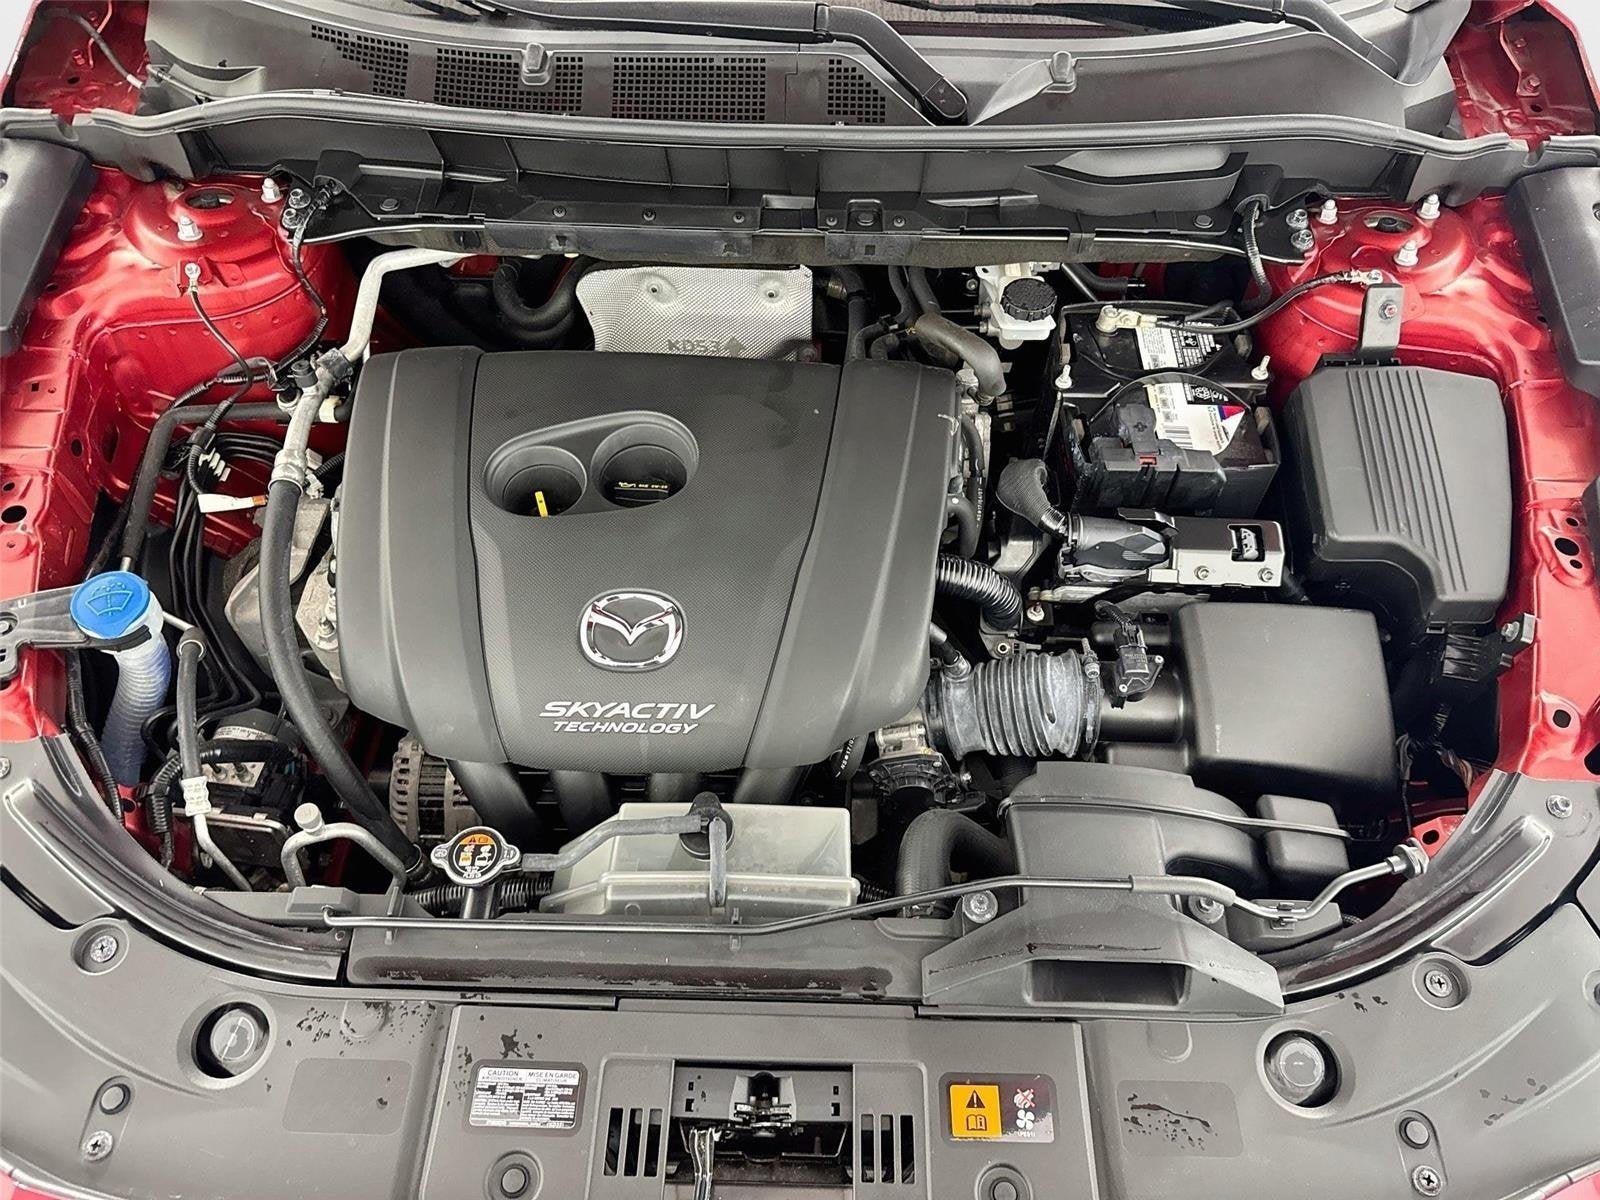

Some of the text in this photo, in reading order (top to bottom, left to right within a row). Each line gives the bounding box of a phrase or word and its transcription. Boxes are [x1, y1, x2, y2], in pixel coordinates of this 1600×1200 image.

[538, 701, 716, 720] SKYACTIV
[552, 721, 698, 735] TECHNOLOGY
[487, 1069, 519, 1077] CAUTION
[544, 1071, 554, 1079] EN
[554, 1072, 577, 1080] GARDE
